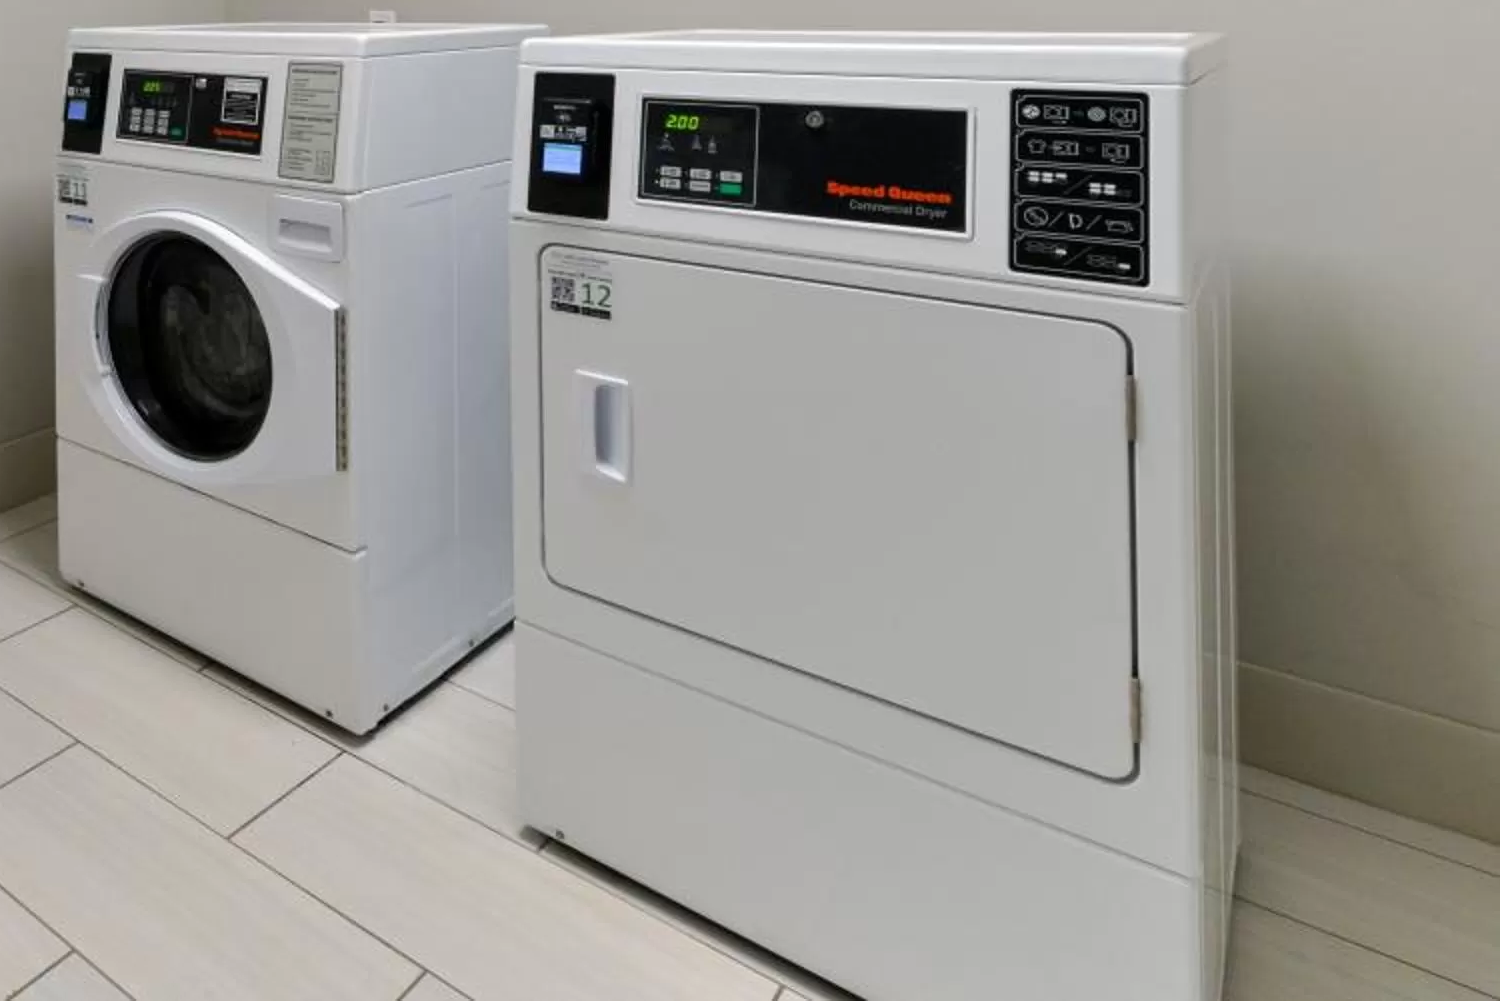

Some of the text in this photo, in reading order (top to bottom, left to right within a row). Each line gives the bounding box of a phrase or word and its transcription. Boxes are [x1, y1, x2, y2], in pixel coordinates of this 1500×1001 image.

[827, 180, 952, 204] Speed Queen
[849, 199, 948, 219] Commercial Dryer
[581, 283, 612, 308] 12
